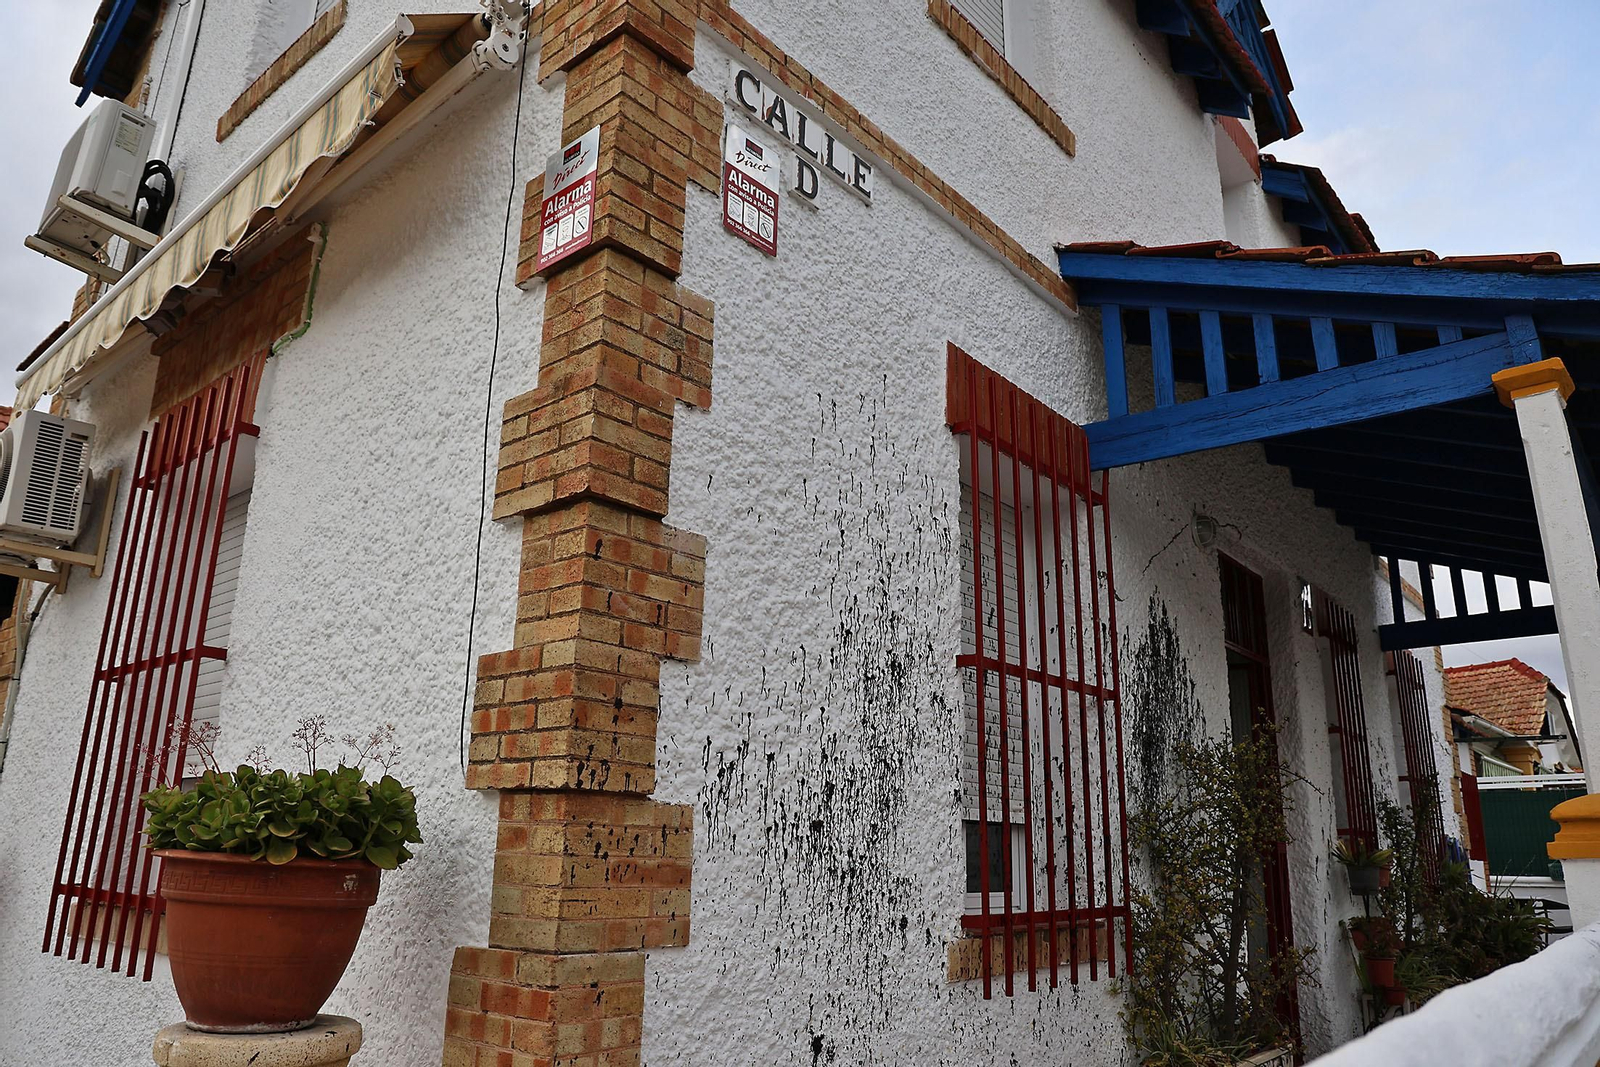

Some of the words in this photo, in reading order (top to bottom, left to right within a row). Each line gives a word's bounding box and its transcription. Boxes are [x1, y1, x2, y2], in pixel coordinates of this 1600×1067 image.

[735, 69, 872, 198] CALLE
[553, 149, 591, 190] Direct
[735, 150, 772, 172] Direct
[795, 155, 819, 199] D
[545, 180, 592, 217] Alarma
[728, 169, 775, 209] Alarma
[728, 184, 739, 193] con
[739, 190, 753, 202] aviso
[544, 216, 554, 226] con
[554, 207, 568, 220] aviso
